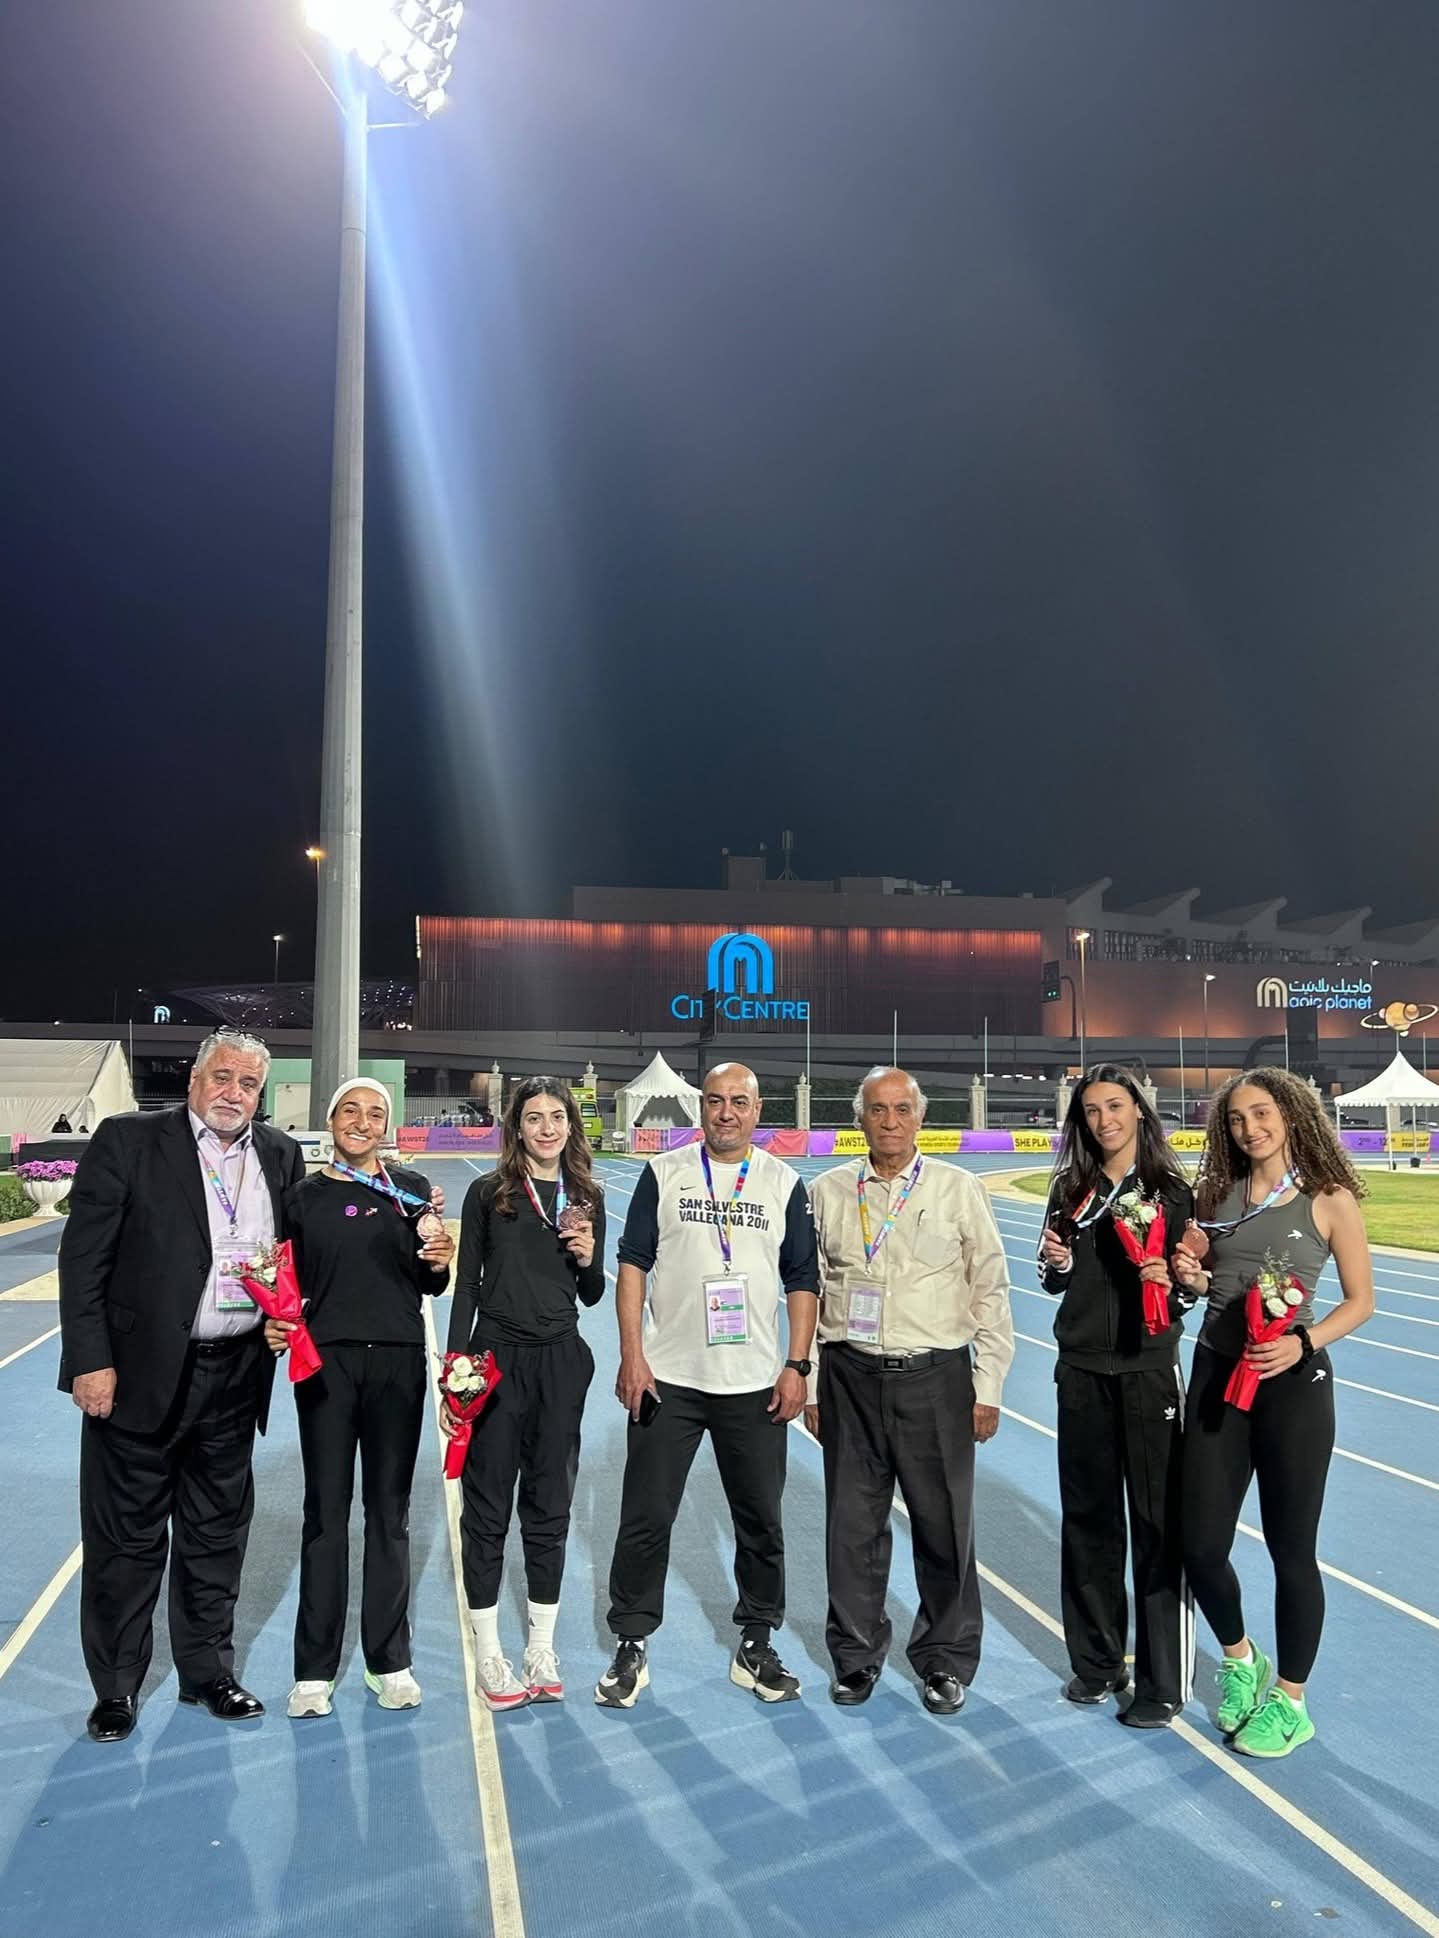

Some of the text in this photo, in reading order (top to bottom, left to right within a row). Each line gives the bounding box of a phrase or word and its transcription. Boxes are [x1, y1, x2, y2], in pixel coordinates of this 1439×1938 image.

[671, 994, 809, 1020] CIT CENTRE
[1325, 995, 1373, 1012] planet
[1015, 1138, 1031, 1147] SHE
[679, 1198, 703, 1210] SAN
[747, 1216, 769, 1231] 2011
